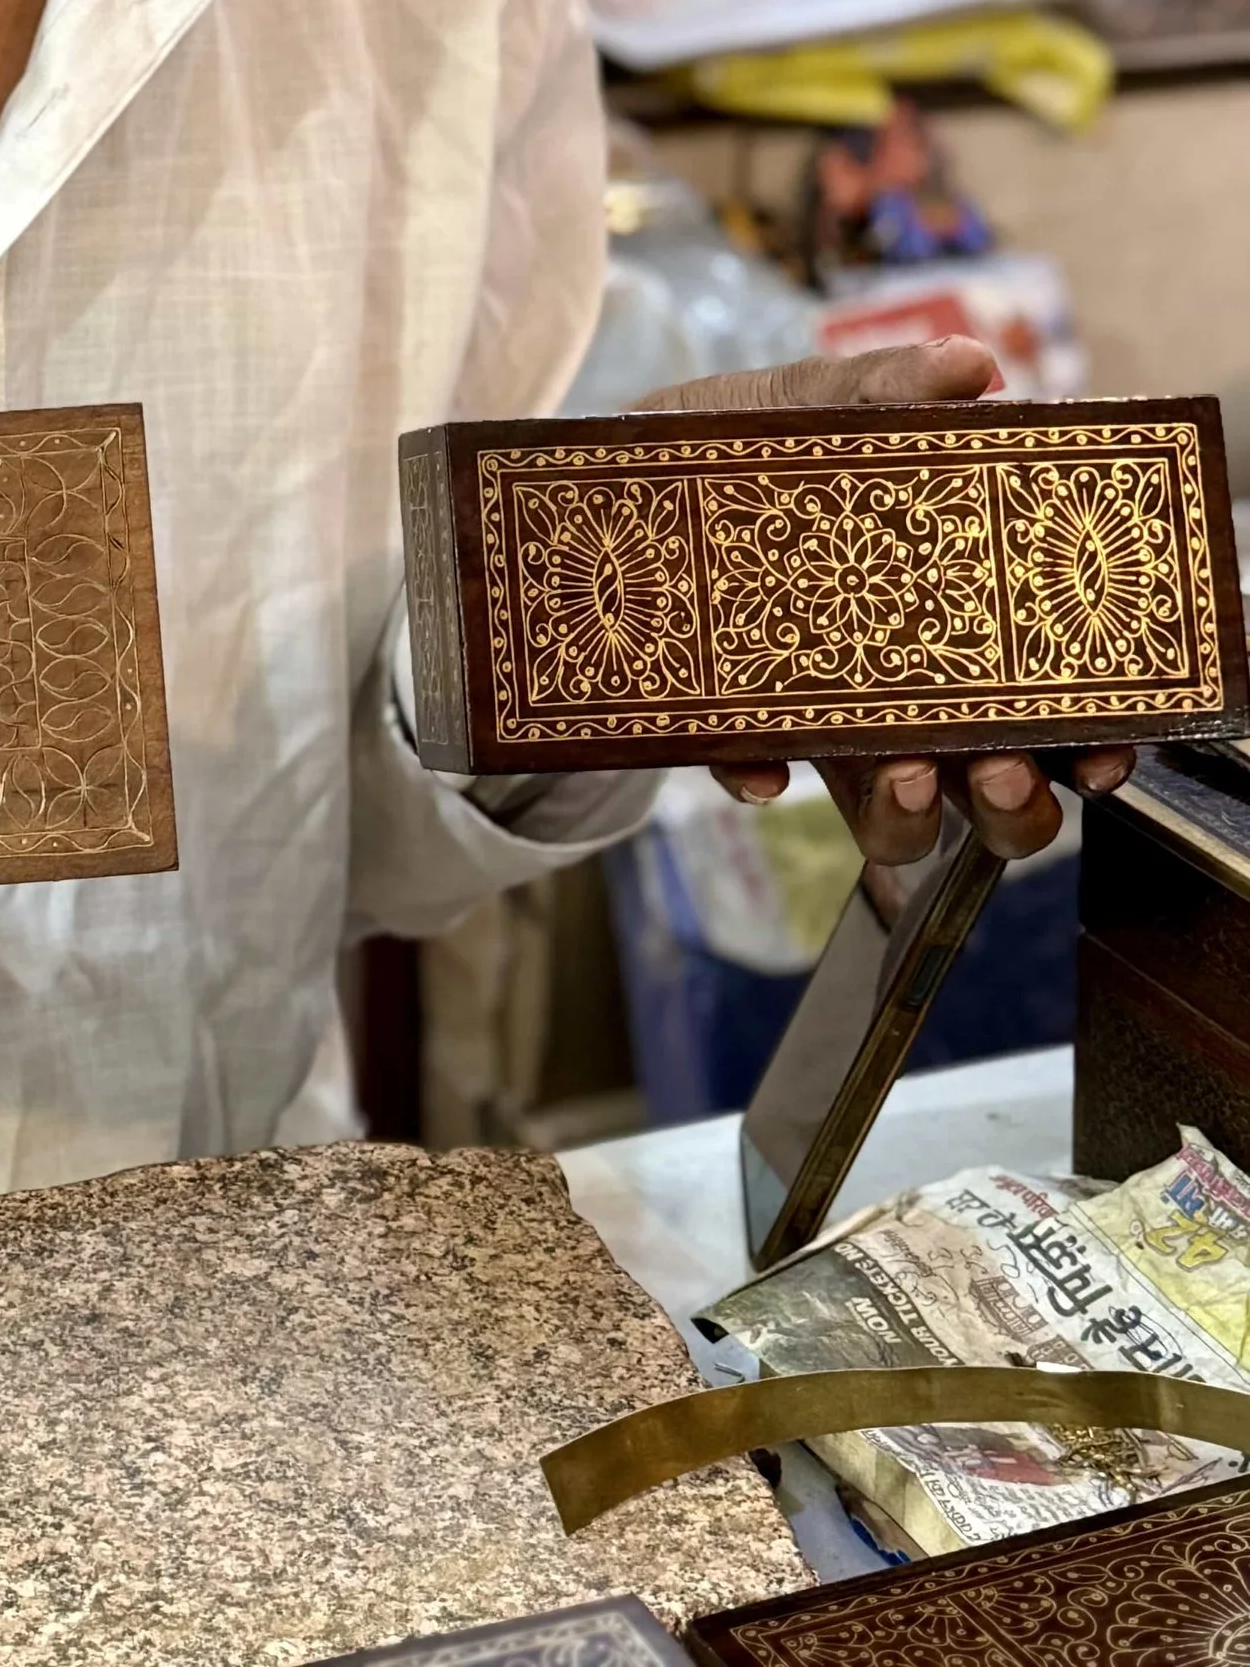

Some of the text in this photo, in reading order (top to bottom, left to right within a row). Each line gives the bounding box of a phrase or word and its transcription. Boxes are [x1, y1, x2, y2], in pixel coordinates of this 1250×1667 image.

[853, 1257, 911, 1324] TICKETS
[846, 1295, 902, 1343] NOW
[1079, 1305, 1142, 1343] है
[909, 1325, 959, 1366] YOUR
